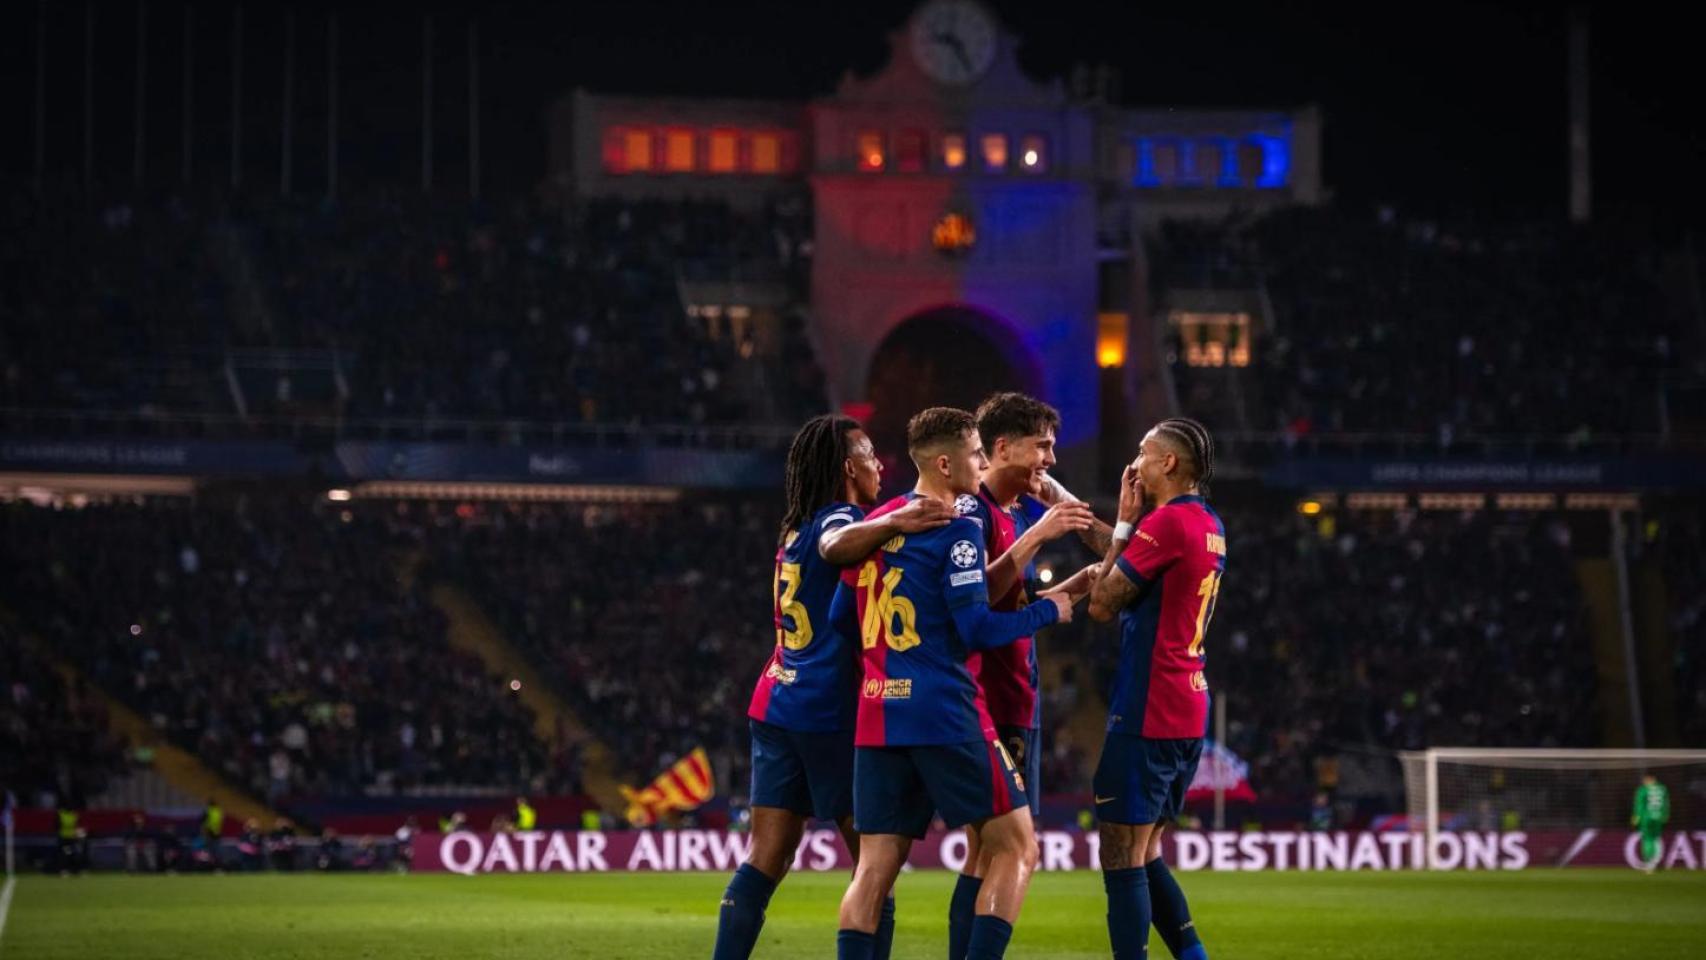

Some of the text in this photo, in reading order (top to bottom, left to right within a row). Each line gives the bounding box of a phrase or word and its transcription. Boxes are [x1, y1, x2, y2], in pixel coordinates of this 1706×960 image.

[857, 560, 922, 653] 16
[439, 829, 609, 875] QATAR
[627, 829, 839, 872] AIRWYS
[1173, 830, 1530, 872] DESTINATIONS
